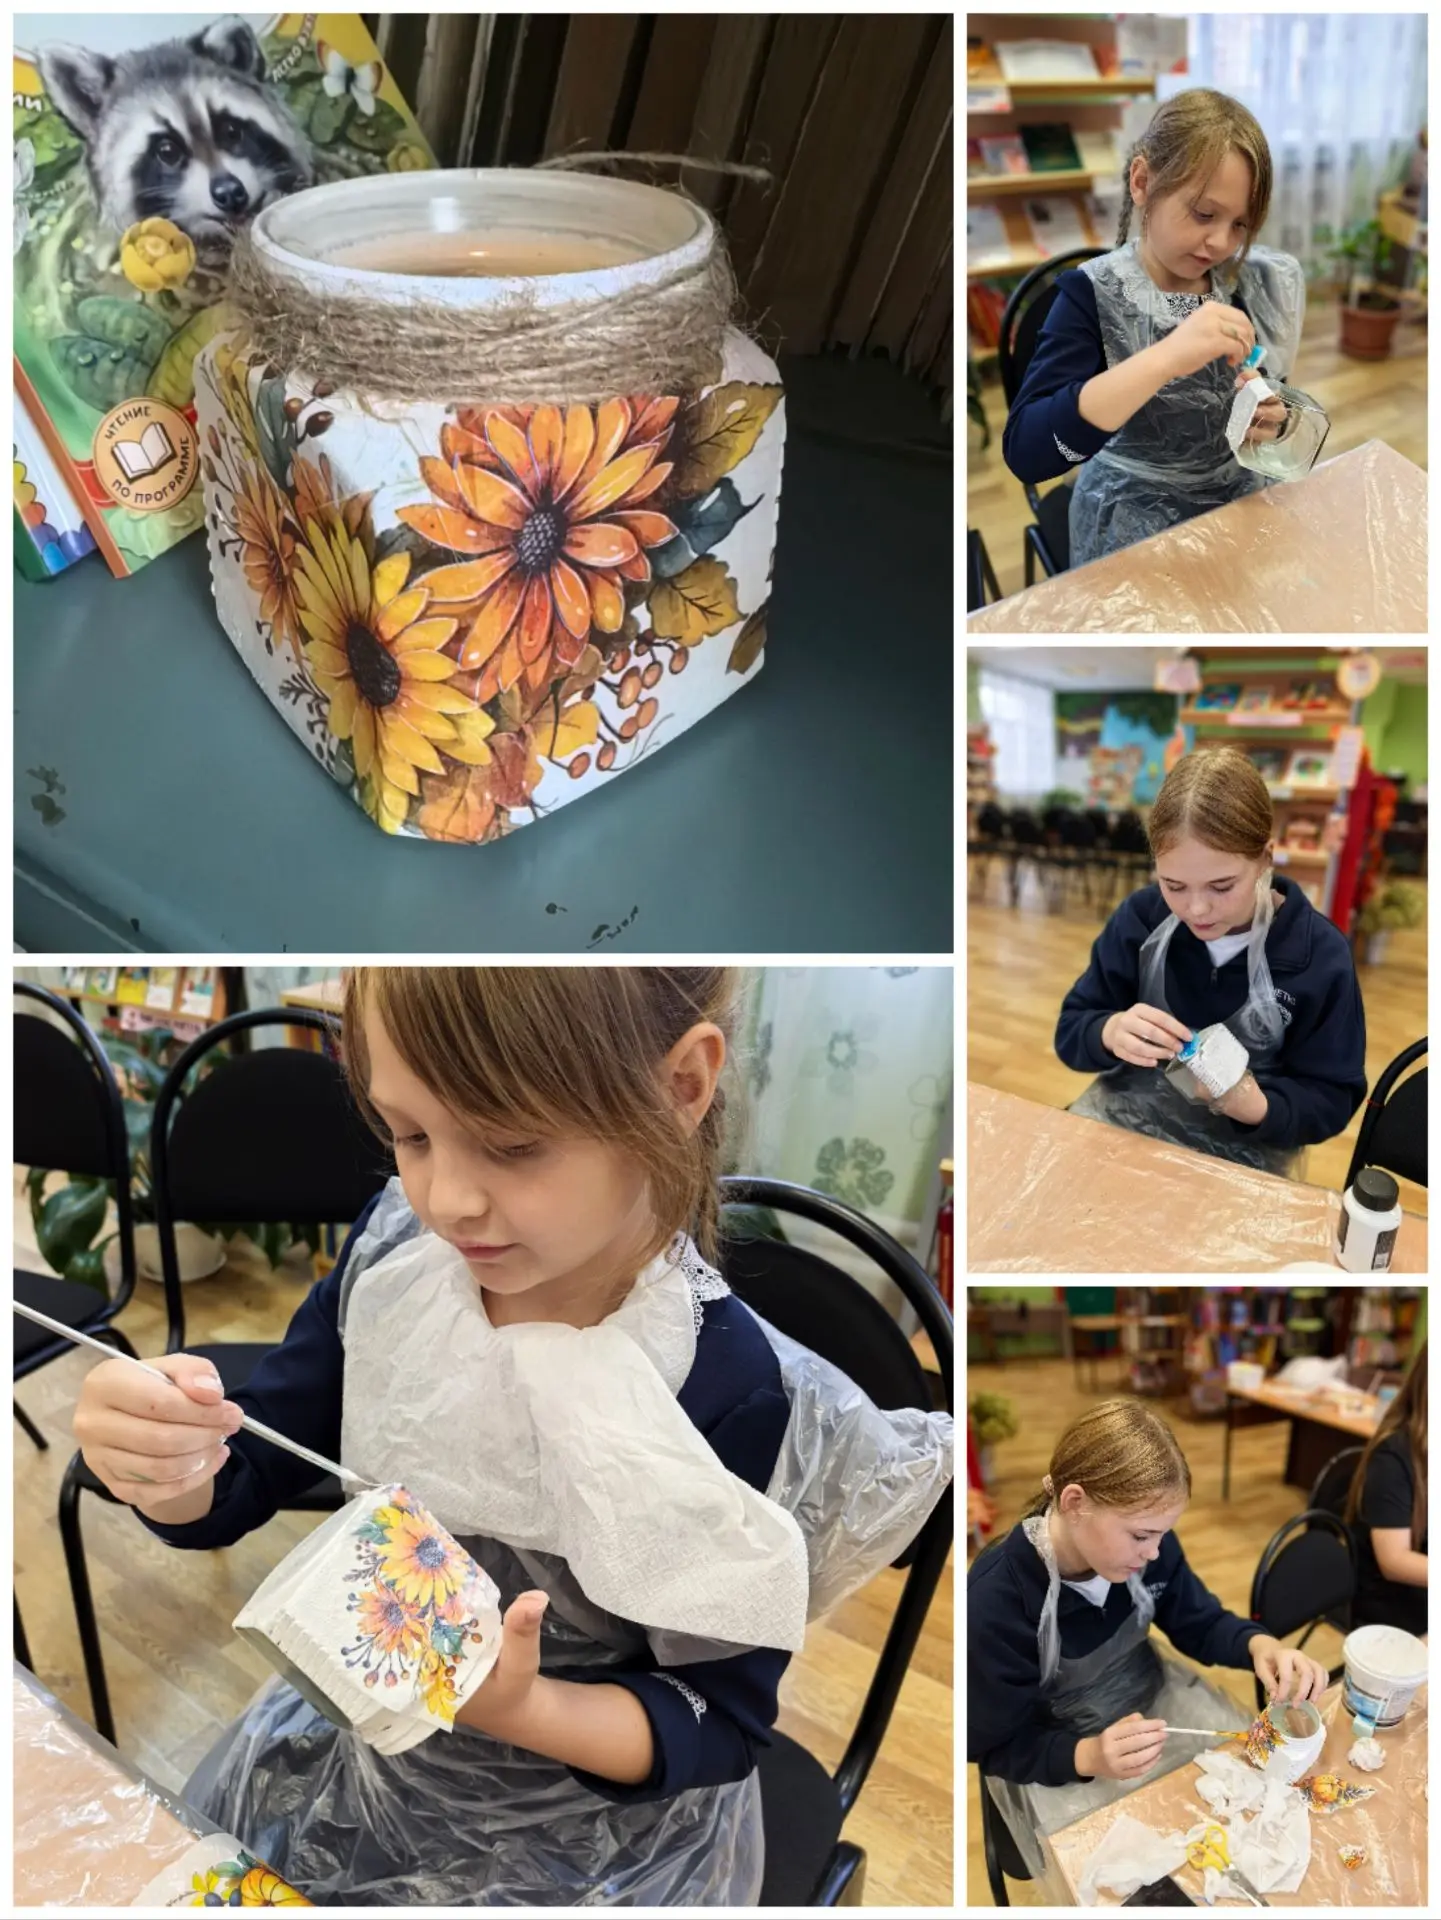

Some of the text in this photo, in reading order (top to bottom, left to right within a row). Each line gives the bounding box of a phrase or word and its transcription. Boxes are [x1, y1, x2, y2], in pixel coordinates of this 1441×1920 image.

[105, 406, 151, 439] ЧТЕНИЕ
[112, 436, 190, 503] ПО ПРОГРАММЕ
